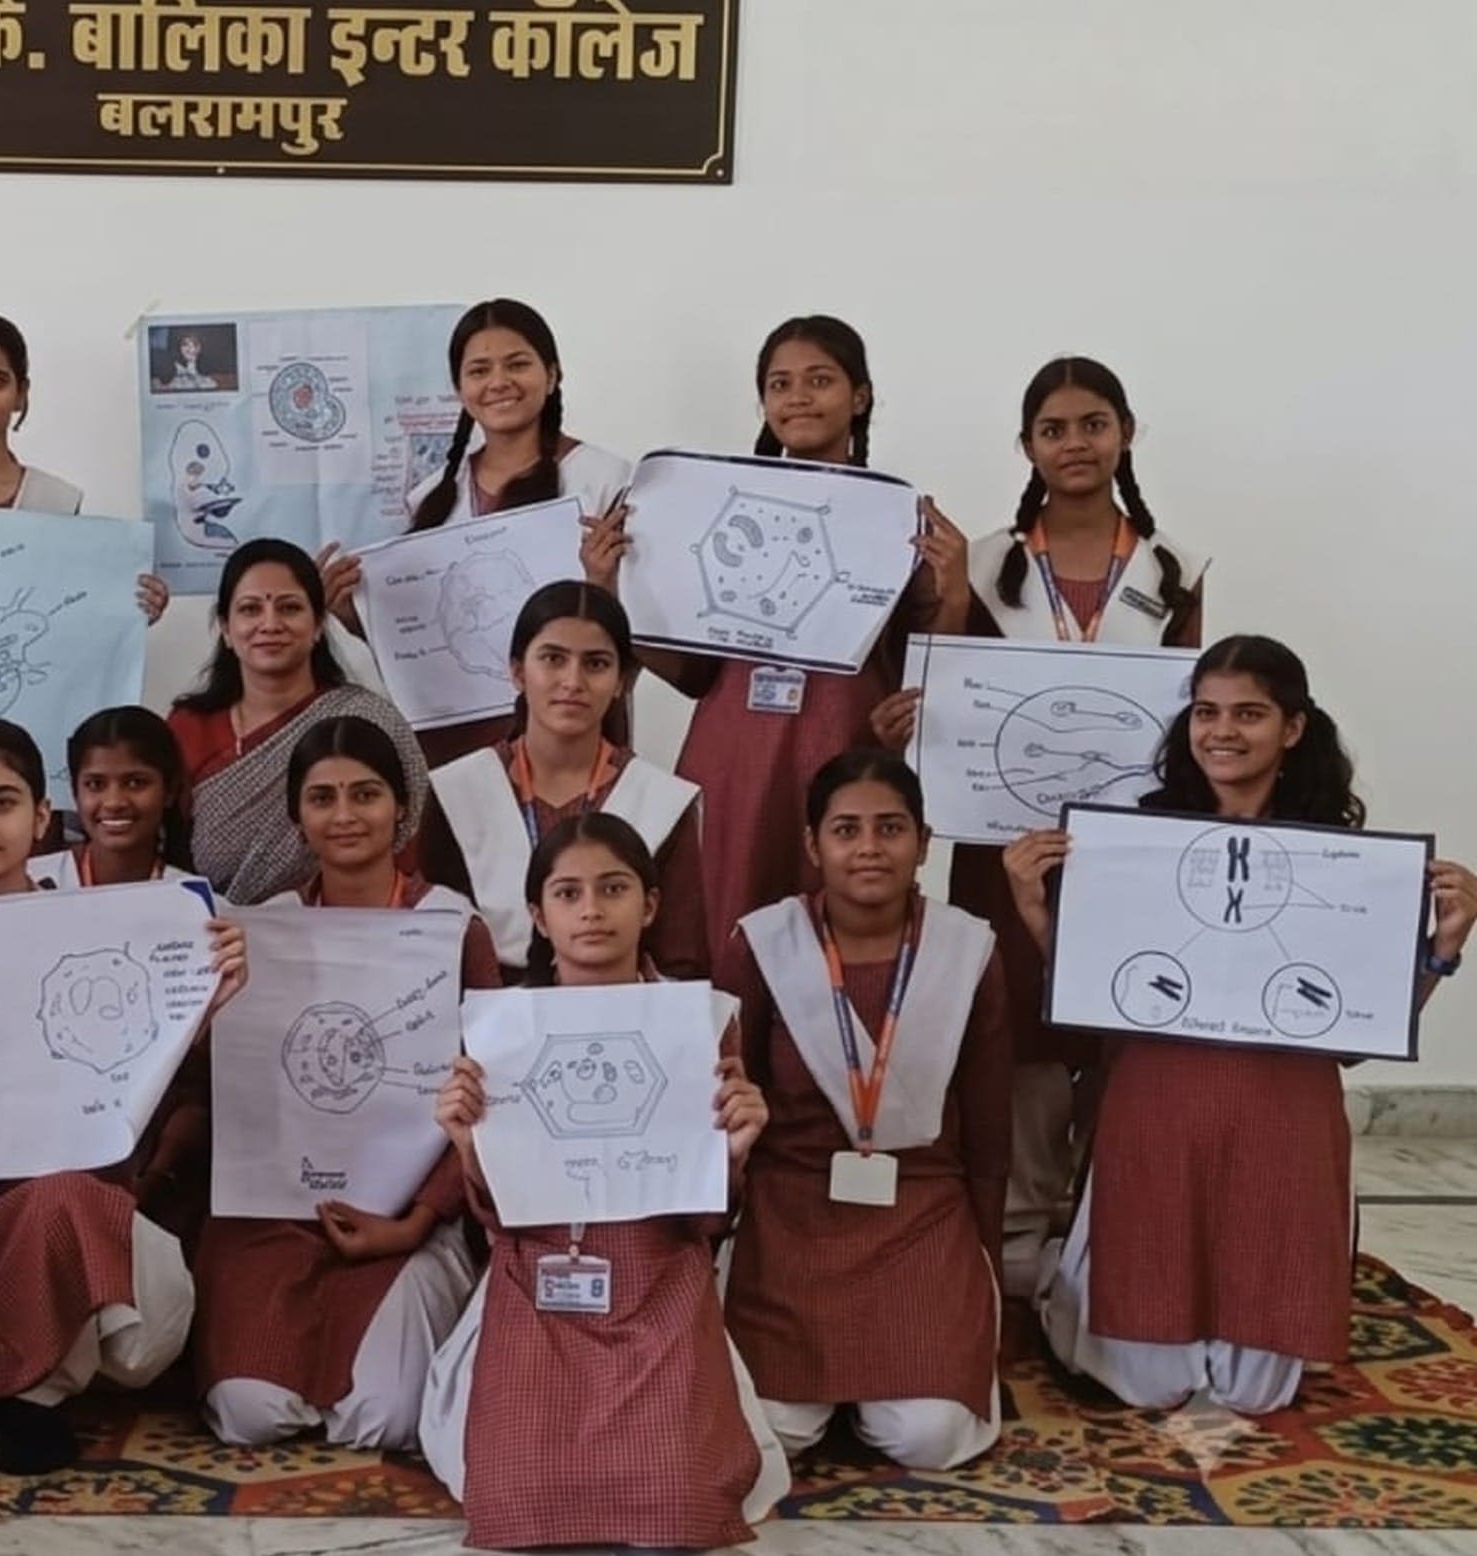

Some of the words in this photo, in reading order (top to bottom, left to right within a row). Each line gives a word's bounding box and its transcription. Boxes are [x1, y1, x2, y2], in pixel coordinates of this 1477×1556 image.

[69, 0, 312, 74] बालिका
[327, 8, 475, 87] इन्टर
[97, 93, 348, 156] बलरामपुर
